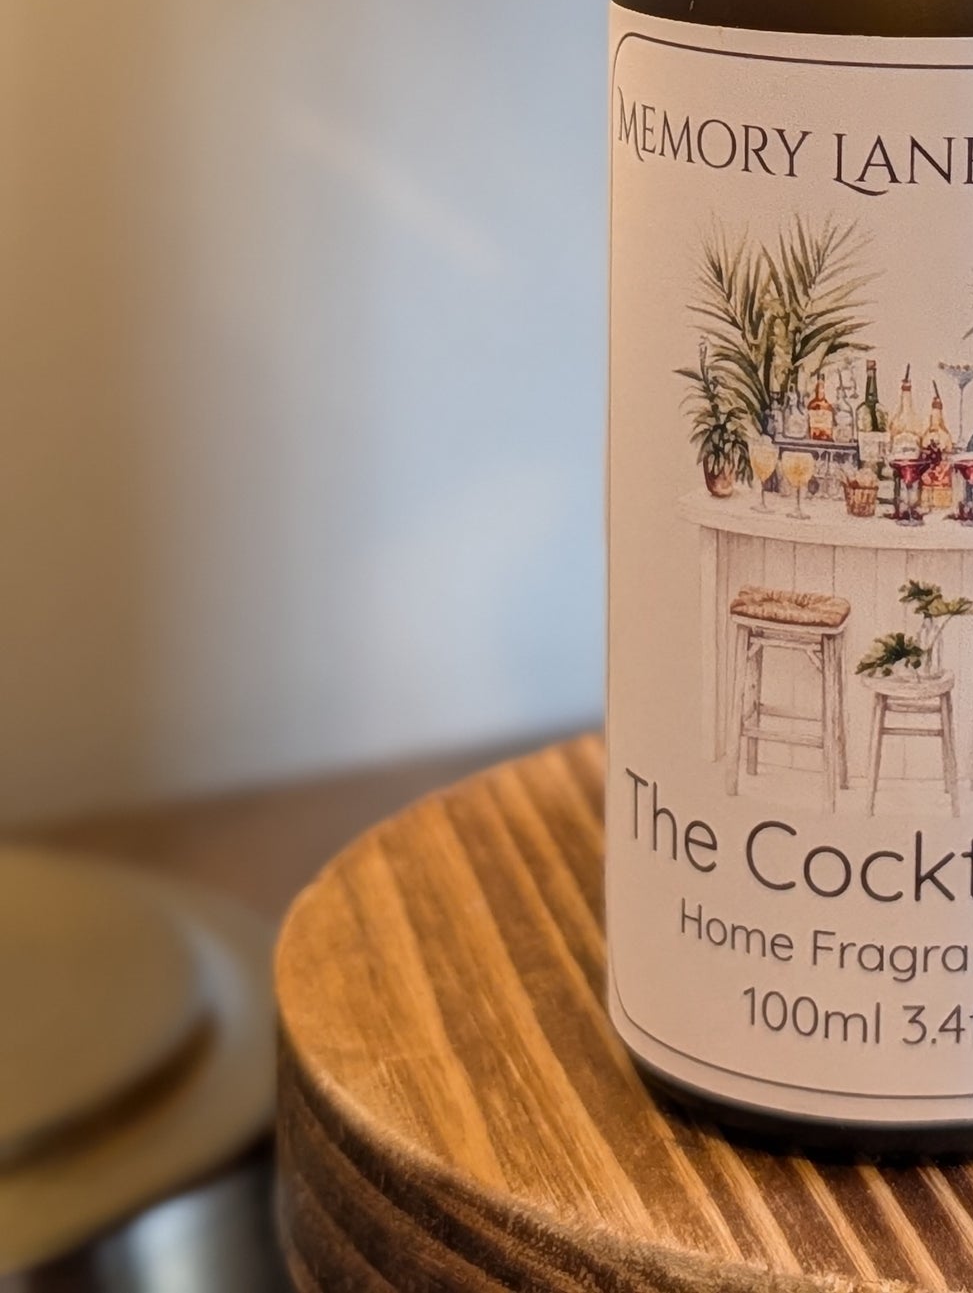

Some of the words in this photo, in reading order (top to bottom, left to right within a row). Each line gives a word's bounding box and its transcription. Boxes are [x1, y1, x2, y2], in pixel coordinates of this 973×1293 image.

[617, 86, 813, 178] MEMORY
[625, 767, 719, 873] The
[680, 897, 795, 962] Home
[742, 986, 881, 1044] 100ml
